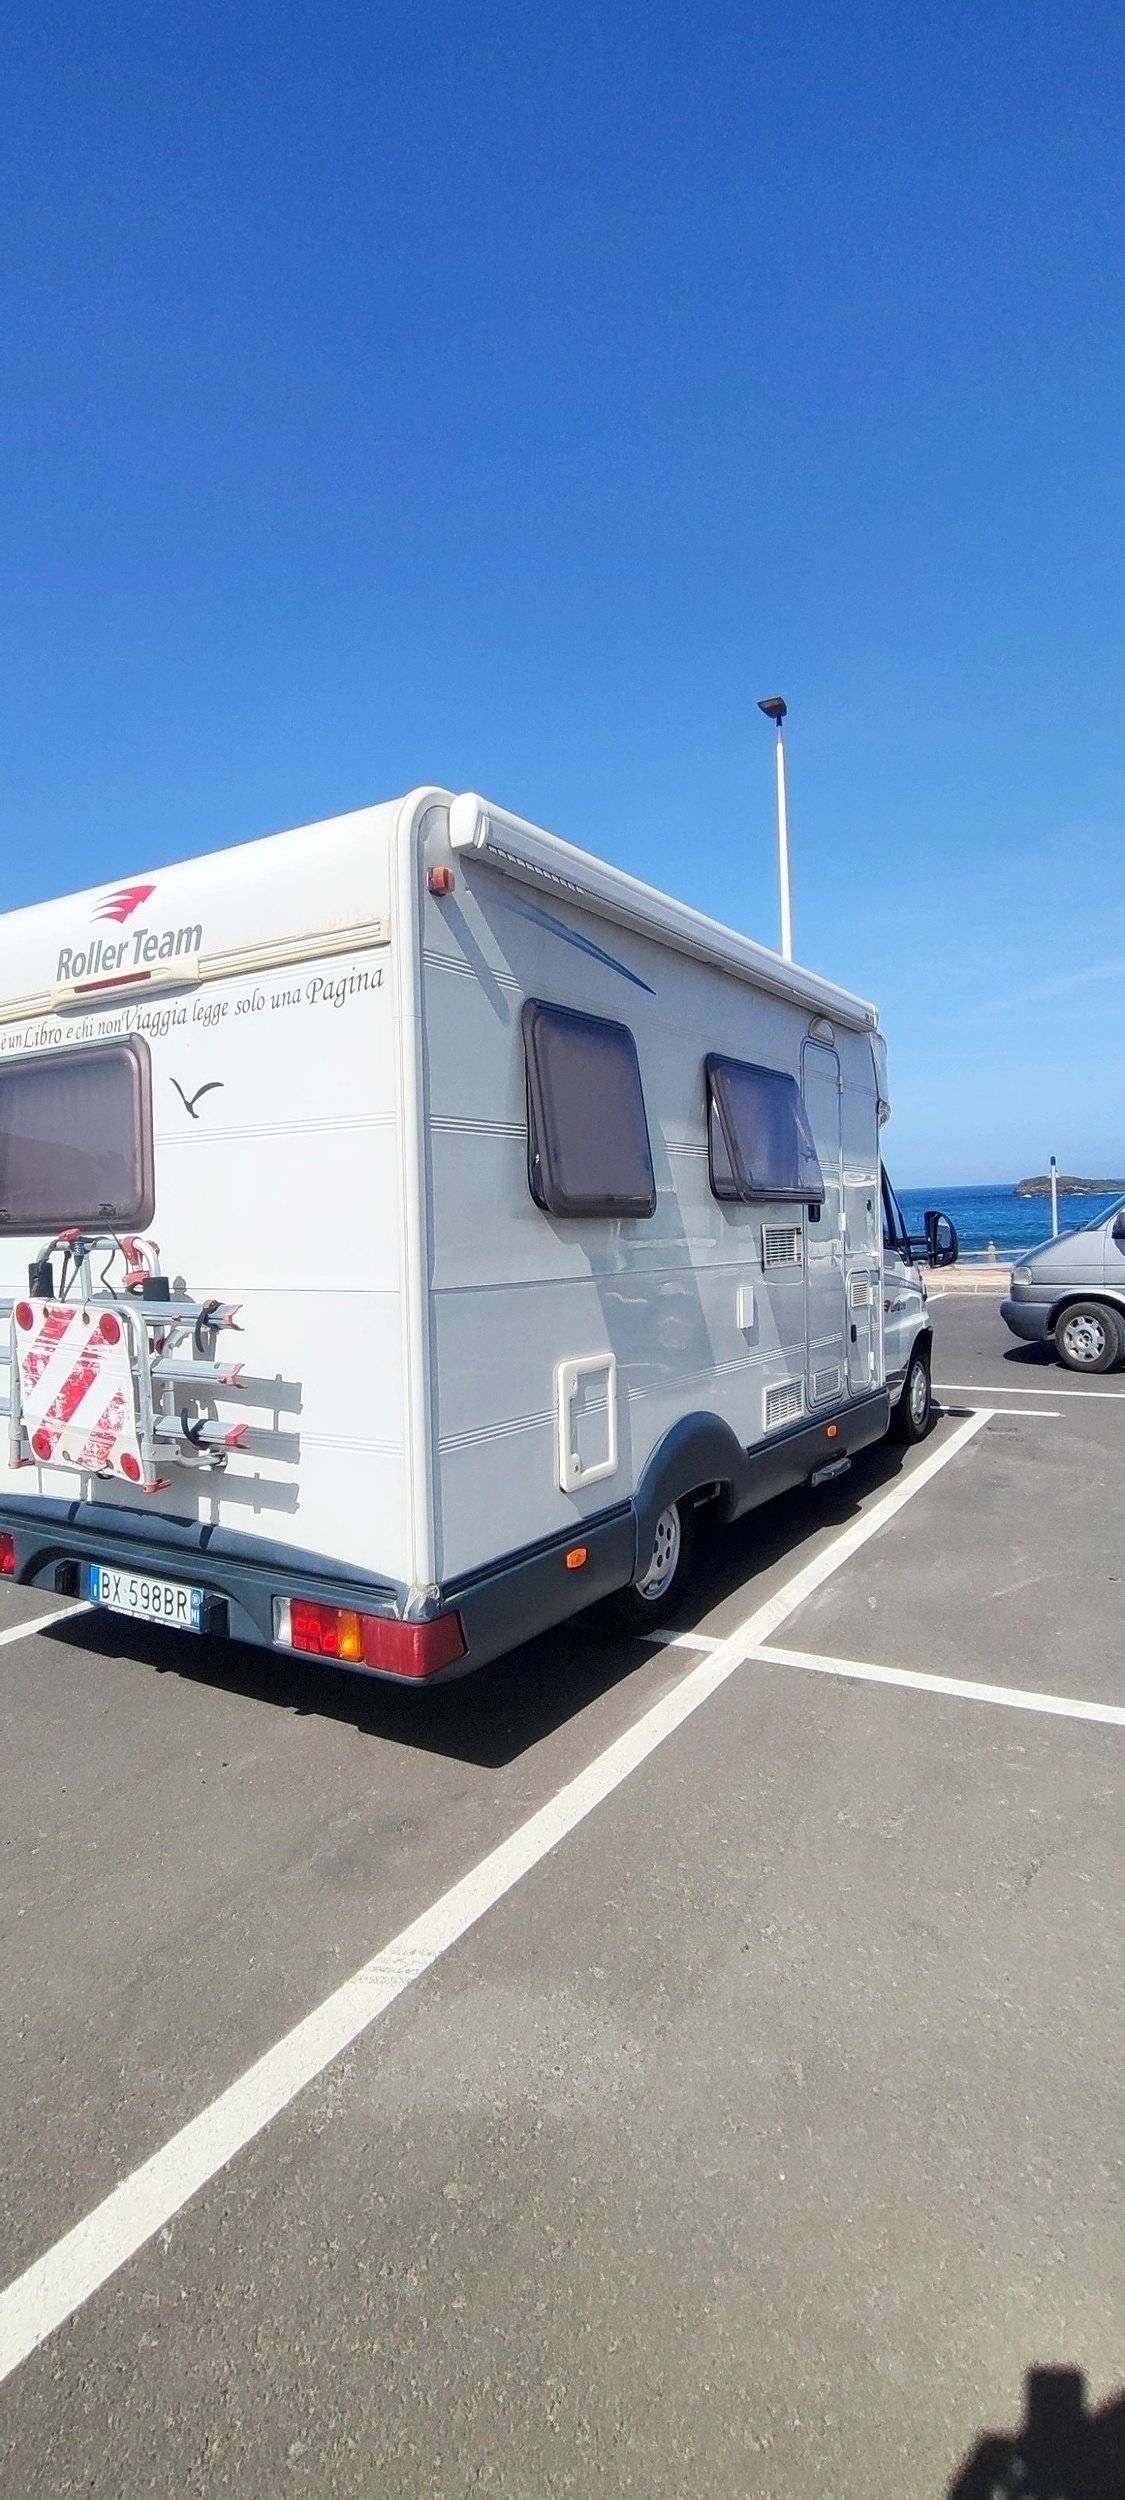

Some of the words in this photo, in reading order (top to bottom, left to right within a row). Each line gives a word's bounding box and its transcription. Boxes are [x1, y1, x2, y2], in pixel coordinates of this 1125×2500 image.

[56, 940, 129, 981] Roller
[133, 924, 202, 964] Team
[9, 1034, 23, 1048] un
[23, 1021, 62, 1049] Libro
[66, 1026, 73, 1039] e
[76, 1016, 94, 1039] chi
[98, 1018, 121, 1033] non
[122, 1001, 187, 1037] Viaggia
[192, 999, 228, 1027] legge
[234, 988, 265, 1016] solo
[270, 988, 302, 1009] una
[306, 966, 384, 1008] Pagina
[102, 1572, 121, 1603] BX
[129, 1579, 187, 1620] 598BR
